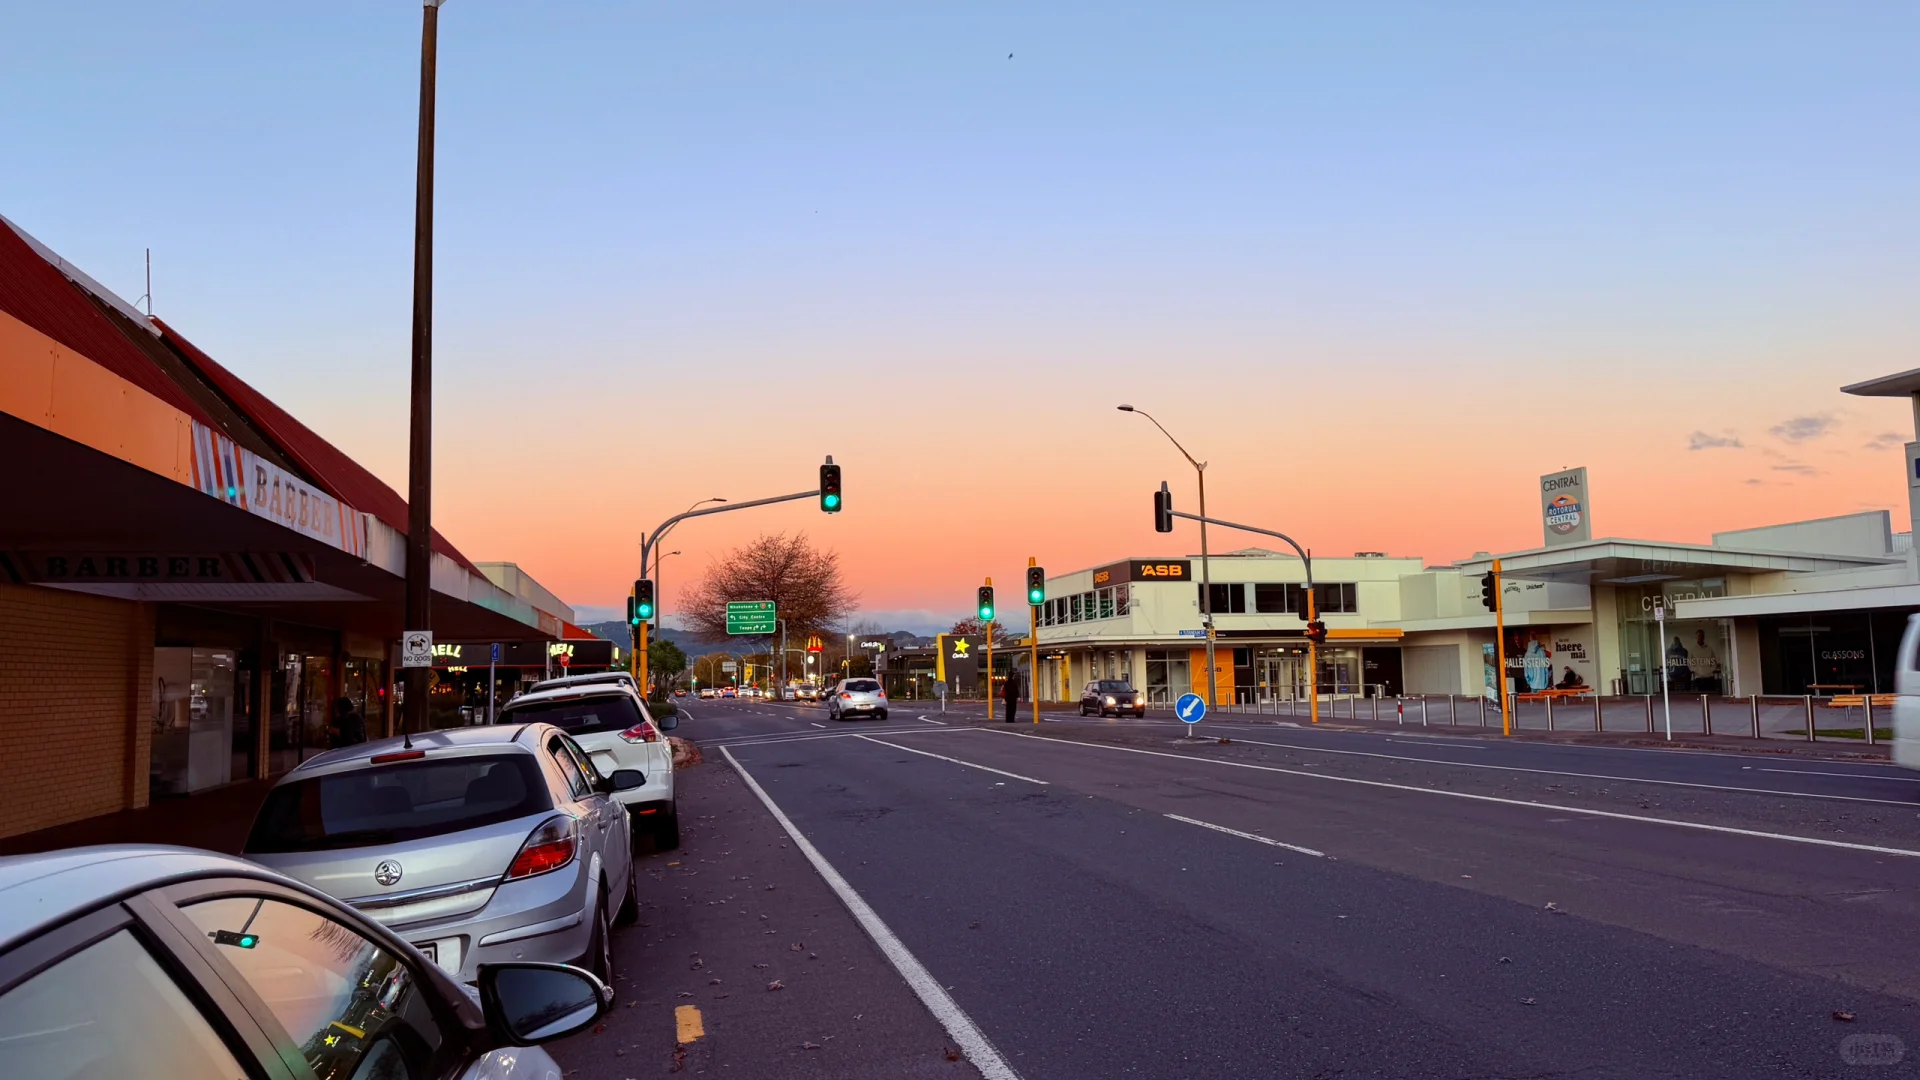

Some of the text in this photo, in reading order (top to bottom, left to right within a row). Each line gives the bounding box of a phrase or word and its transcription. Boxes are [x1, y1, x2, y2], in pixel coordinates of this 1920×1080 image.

[1542, 475, 1580, 492] CENTRAL
[255, 464, 334, 538] BARBER
[1548, 504, 1577, 517] ROTORUA
[1550, 513, 1577, 524] CENTRAL
[46, 556, 222, 577] BARBER
[1141, 565, 1183, 576] ASB
[1094, 571, 1110, 584] ASB
[1555, 642, 1583, 652] haere
[1571, 649, 1586, 659] mai
[1821, 649, 1865, 660] GLASSONS
[1503, 657, 1550, 668] HALLENSTEINS
[1667, 657, 1716, 667] HALLENSTEINS
